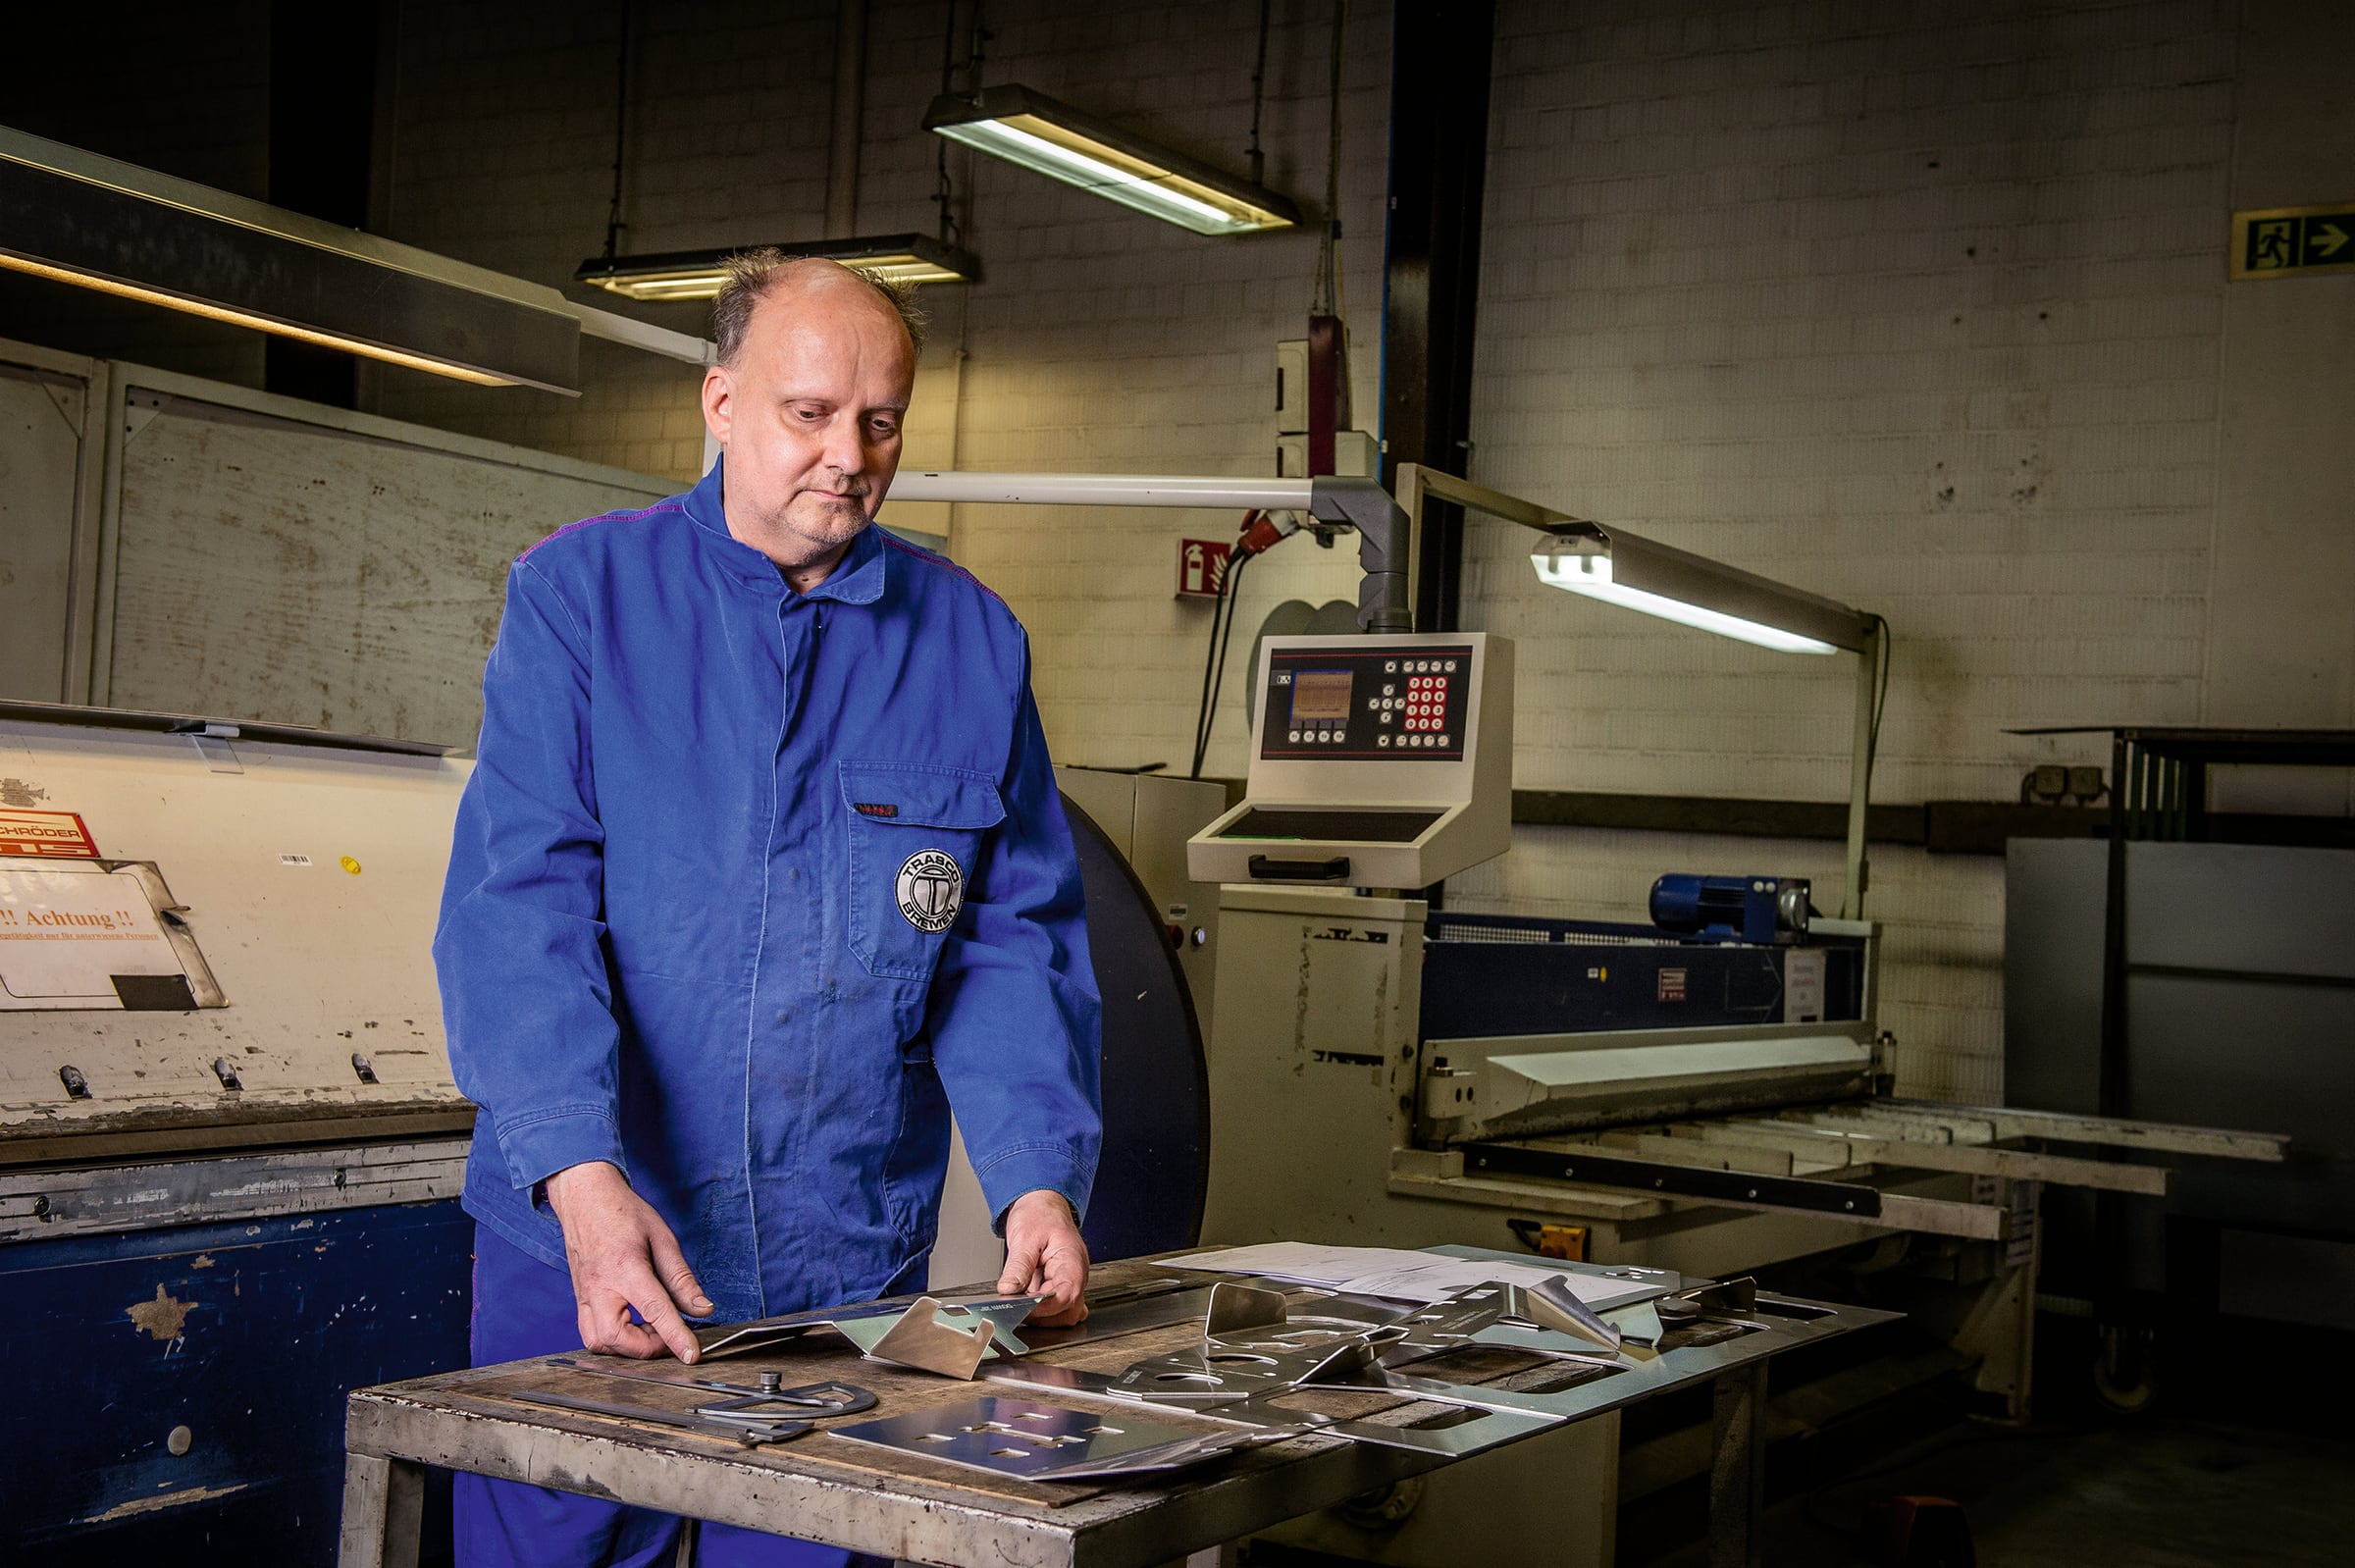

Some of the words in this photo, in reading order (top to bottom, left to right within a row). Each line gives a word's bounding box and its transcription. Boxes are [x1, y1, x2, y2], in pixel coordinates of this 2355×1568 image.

[902, 854, 960, 883] TRASCO
[26, 910, 116, 930] Achtung
[115, 911, 134, 926] !!
[902, 901, 957, 929] BREMEN
